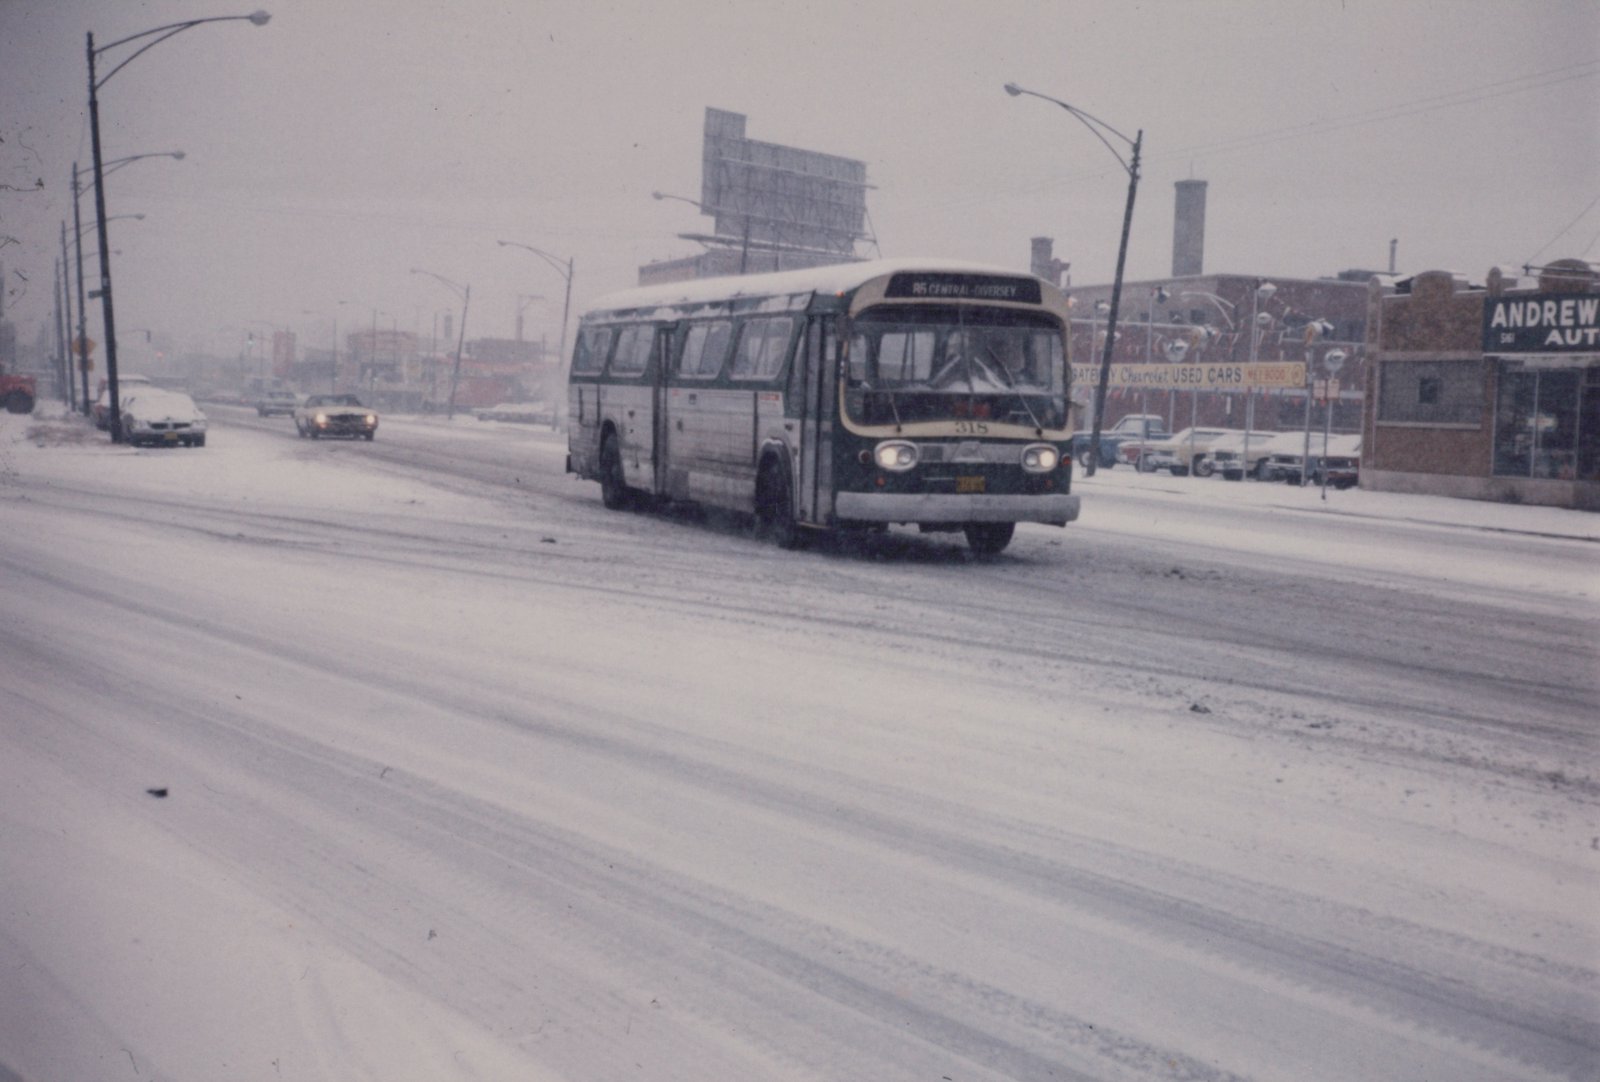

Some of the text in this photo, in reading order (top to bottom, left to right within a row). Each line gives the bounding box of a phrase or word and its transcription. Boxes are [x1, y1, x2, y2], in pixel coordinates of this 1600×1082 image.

[1491, 298, 1599, 328] ANDREW
[1544, 328, 1600, 346] AUT
[1172, 367, 1203, 384] USED
[1207, 366, 1243, 384] CARS
[955, 421, 990, 434] 318
